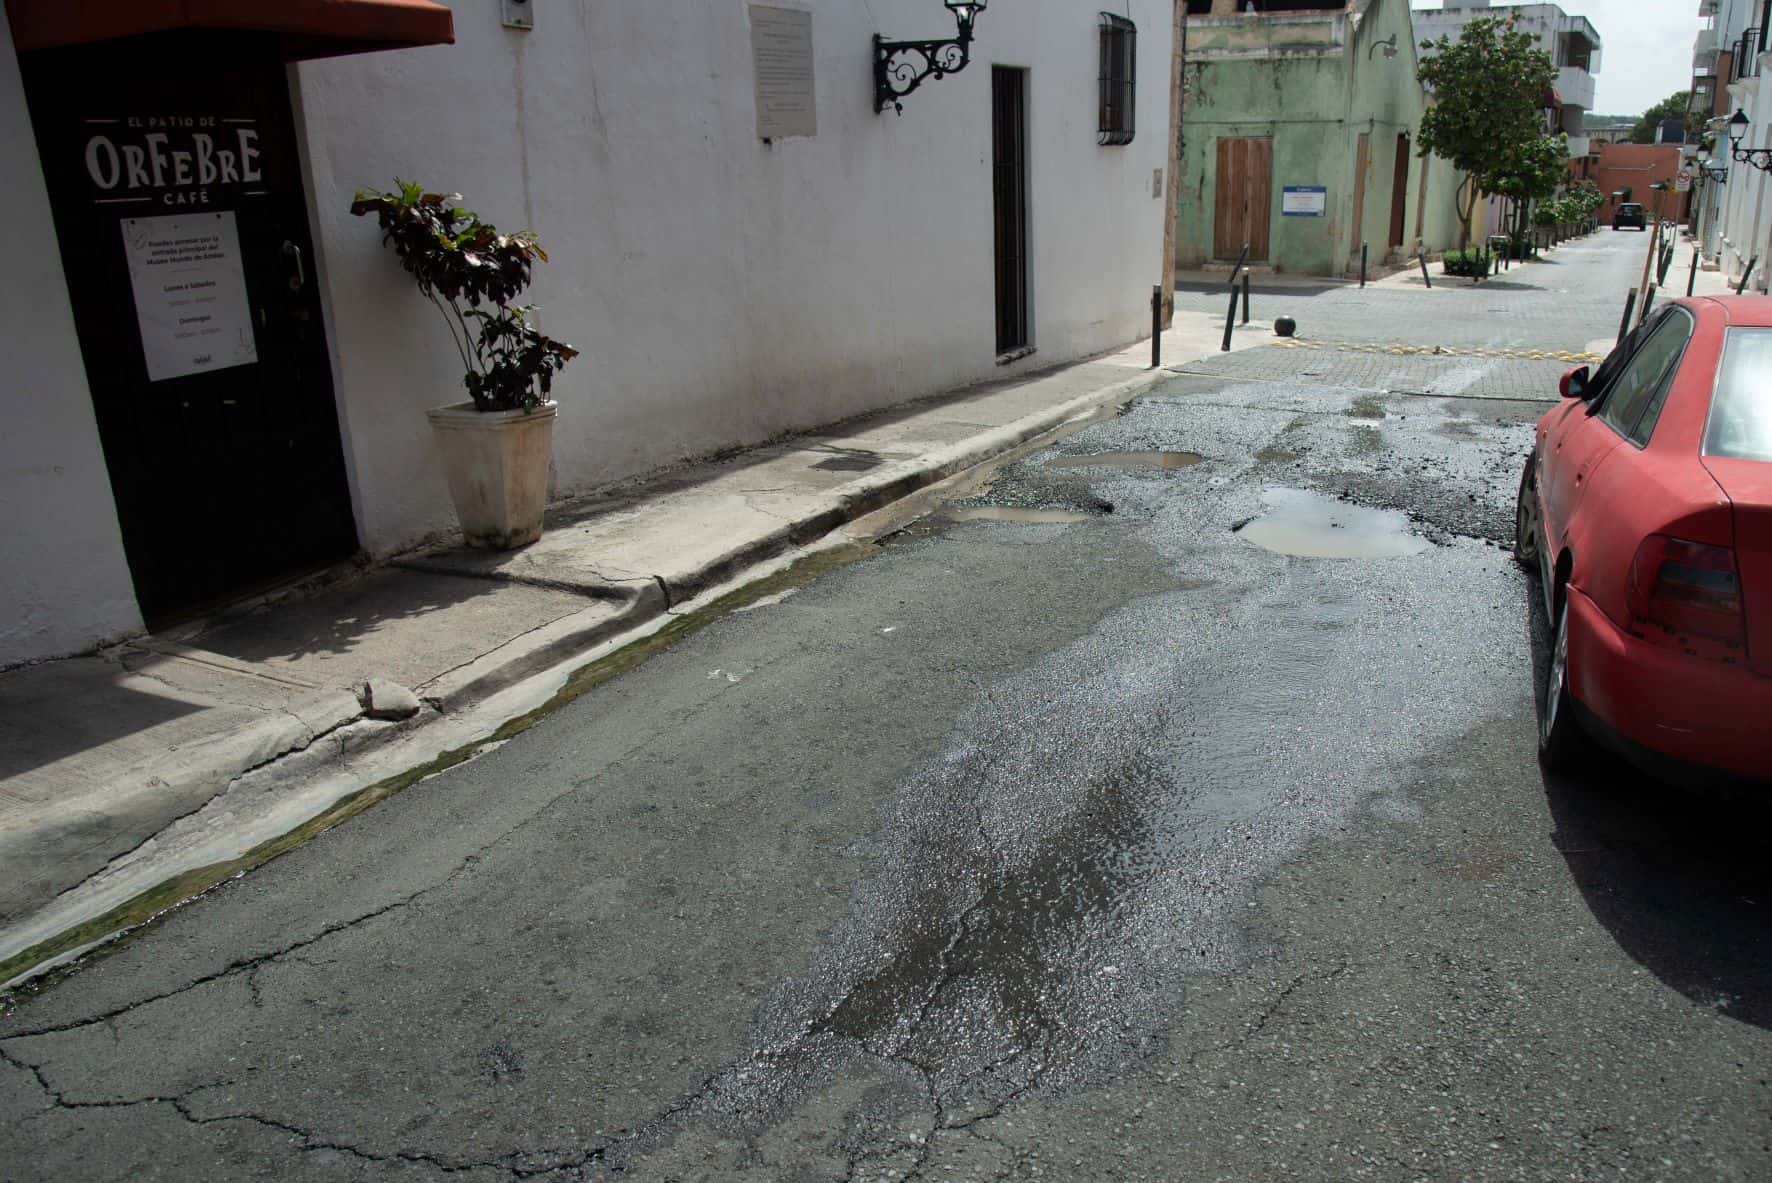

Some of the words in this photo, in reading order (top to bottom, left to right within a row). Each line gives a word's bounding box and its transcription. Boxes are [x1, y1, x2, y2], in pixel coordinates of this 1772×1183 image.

[128, 117, 143, 127] EL
[149, 116, 193, 127] PATIO
[200, 116, 215, 127] DE
[85, 128, 262, 189] ORFEBRE
[163, 188, 209, 205] CAFÉ
[163, 284, 184, 293] Lunes
